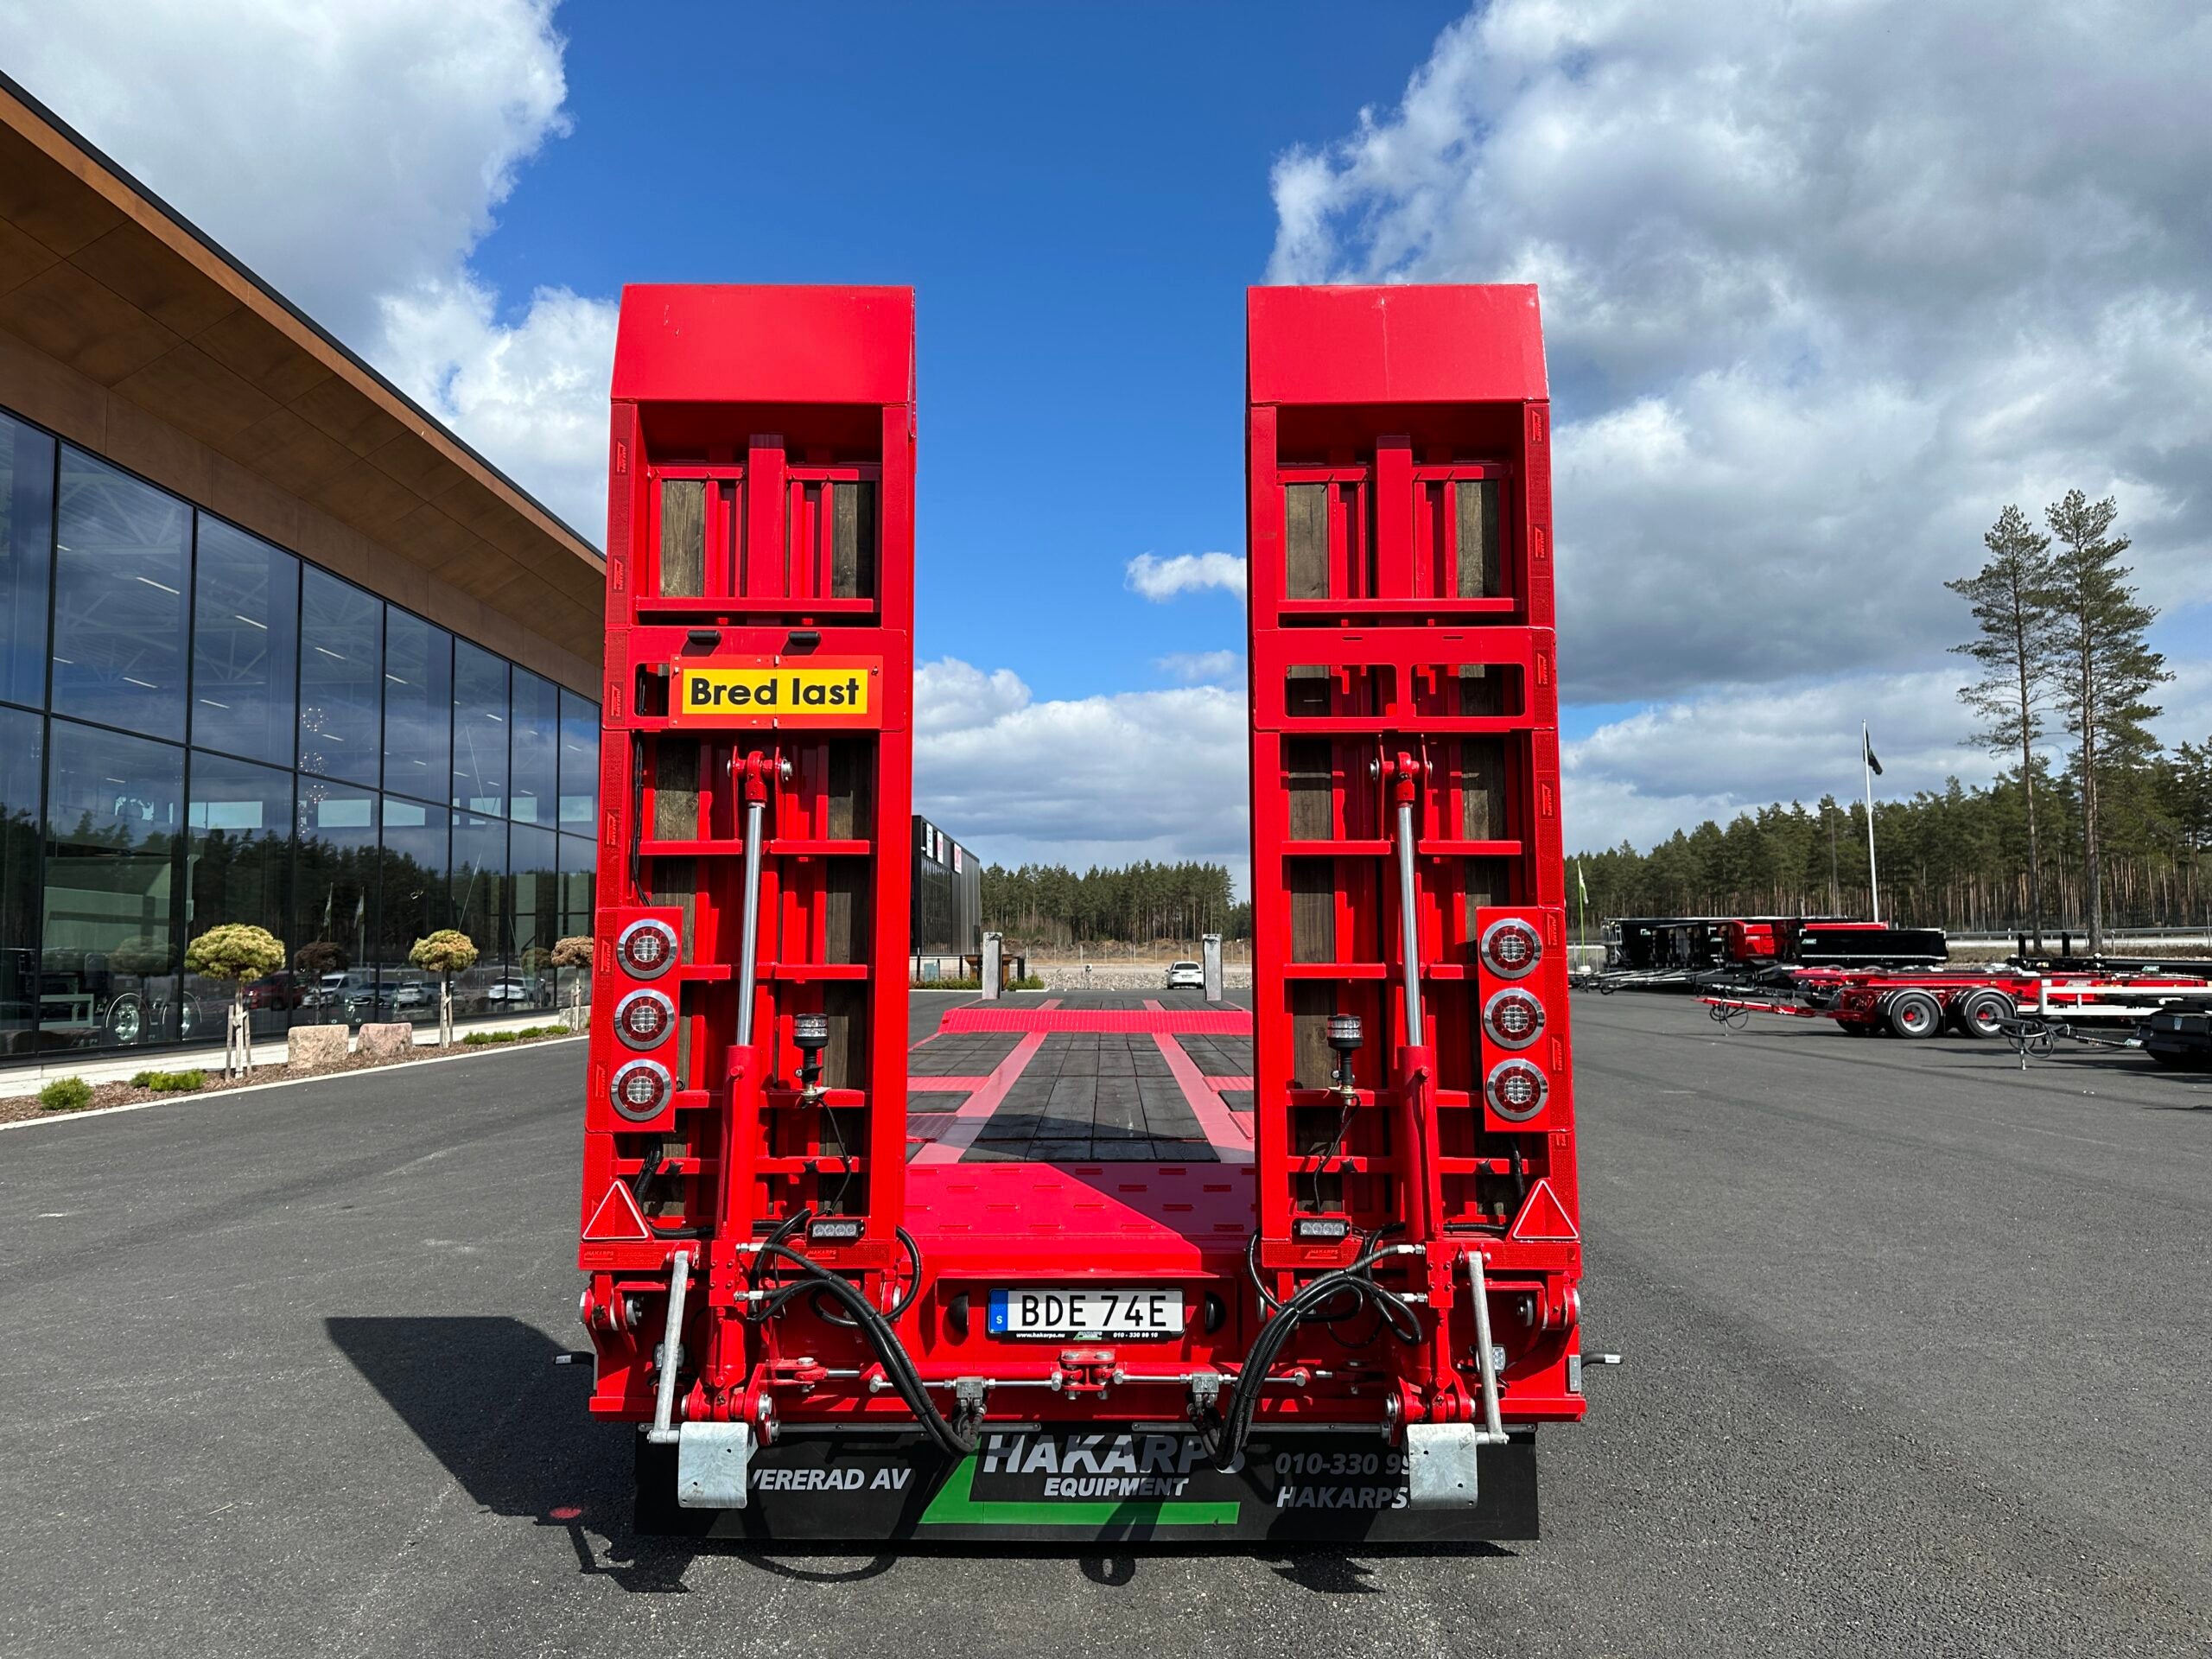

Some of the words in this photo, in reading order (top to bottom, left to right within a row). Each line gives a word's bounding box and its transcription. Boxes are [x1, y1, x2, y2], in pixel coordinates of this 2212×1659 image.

[690, 677, 778, 706] Bred
[791, 677, 860, 706] last
[995, 1315, 1003, 1325] S
[1021, 1294, 1087, 1327] BDE
[1100, 1294, 1166, 1327] 74E
[1274, 1452, 1379, 1475] 010-330
[869, 1468, 912, 1490] AV
[1044, 1478, 1189, 1497] EQUIPMENT
